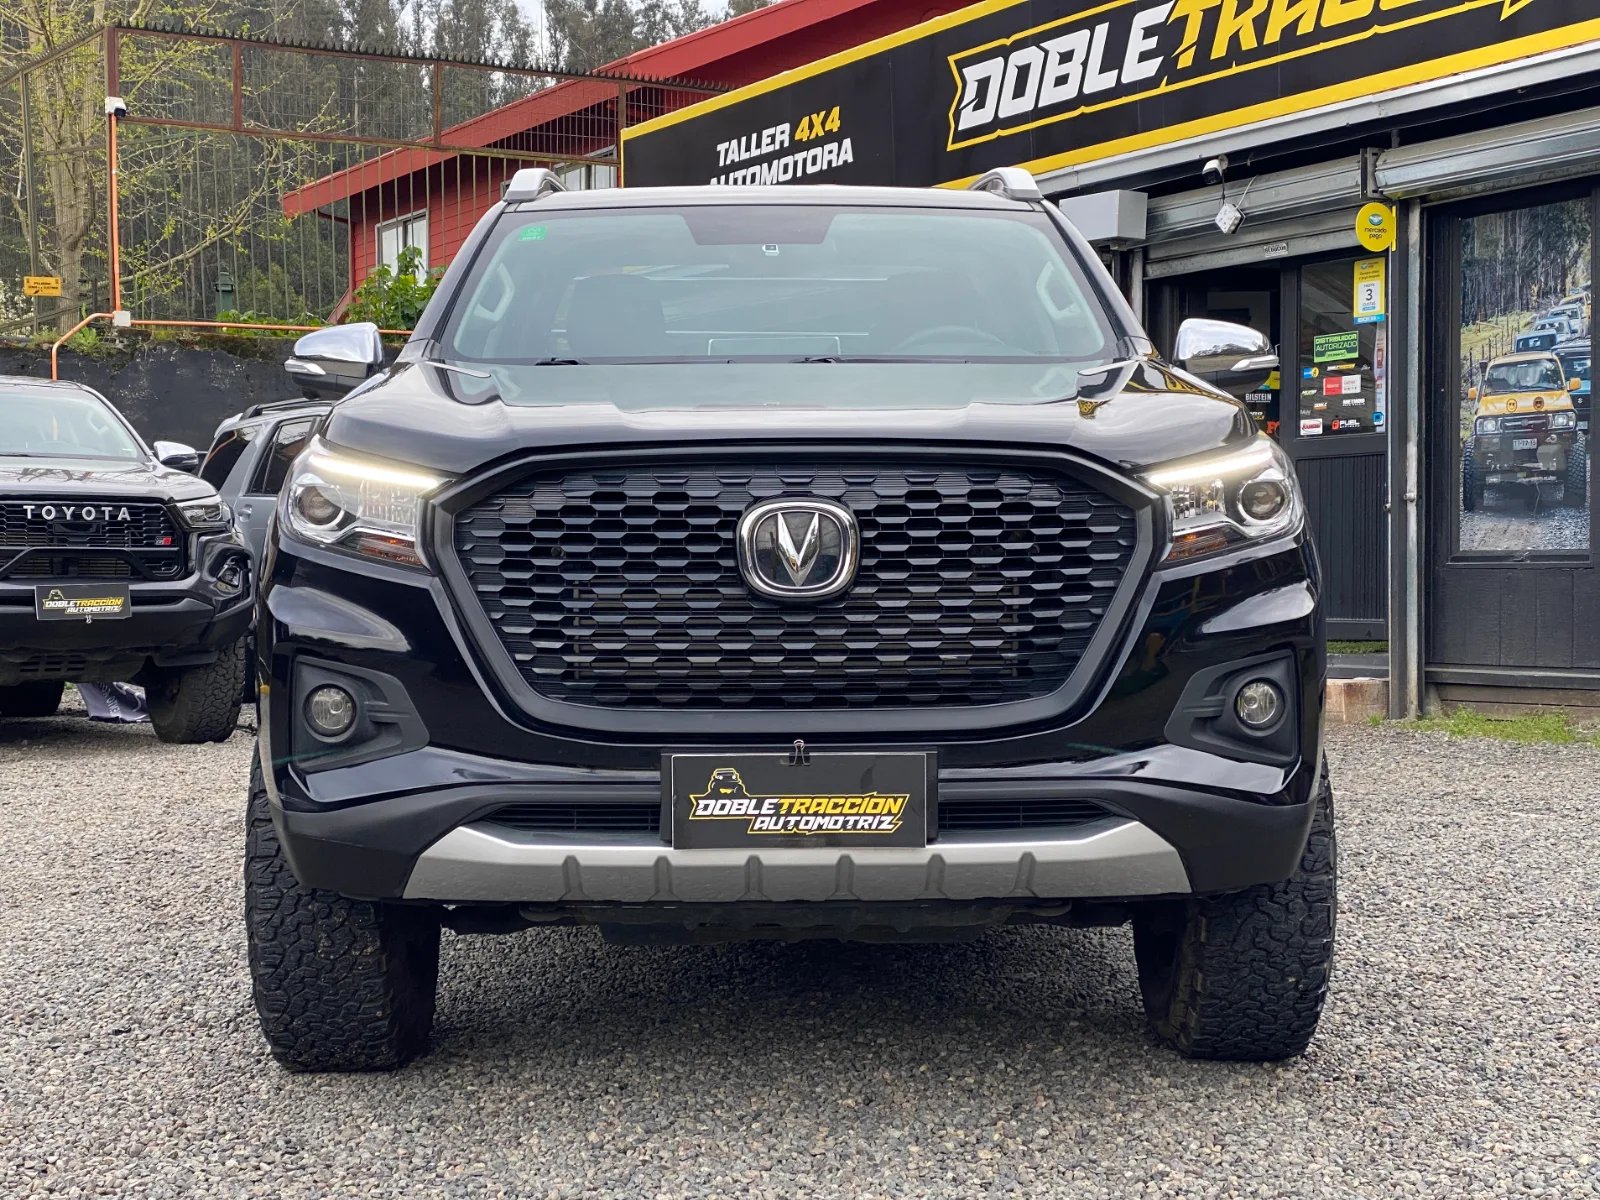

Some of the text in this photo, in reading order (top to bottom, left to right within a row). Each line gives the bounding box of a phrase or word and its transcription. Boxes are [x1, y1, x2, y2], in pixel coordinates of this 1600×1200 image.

[716, 106, 841, 167] TALLER 4X4
[1365, 288, 1374, 302] 3
[1315, 333, 1357, 345] DISTRIBUIDOR
[1315, 340, 1358, 352] AUTORIZADO
[1245, 393, 1272, 401] BILSTEIN
[1339, 419, 1360, 427] FUEL
[22, 505, 131, 521] TOYOTA
[753, 815, 895, 831] AUTOMOTRIZ
